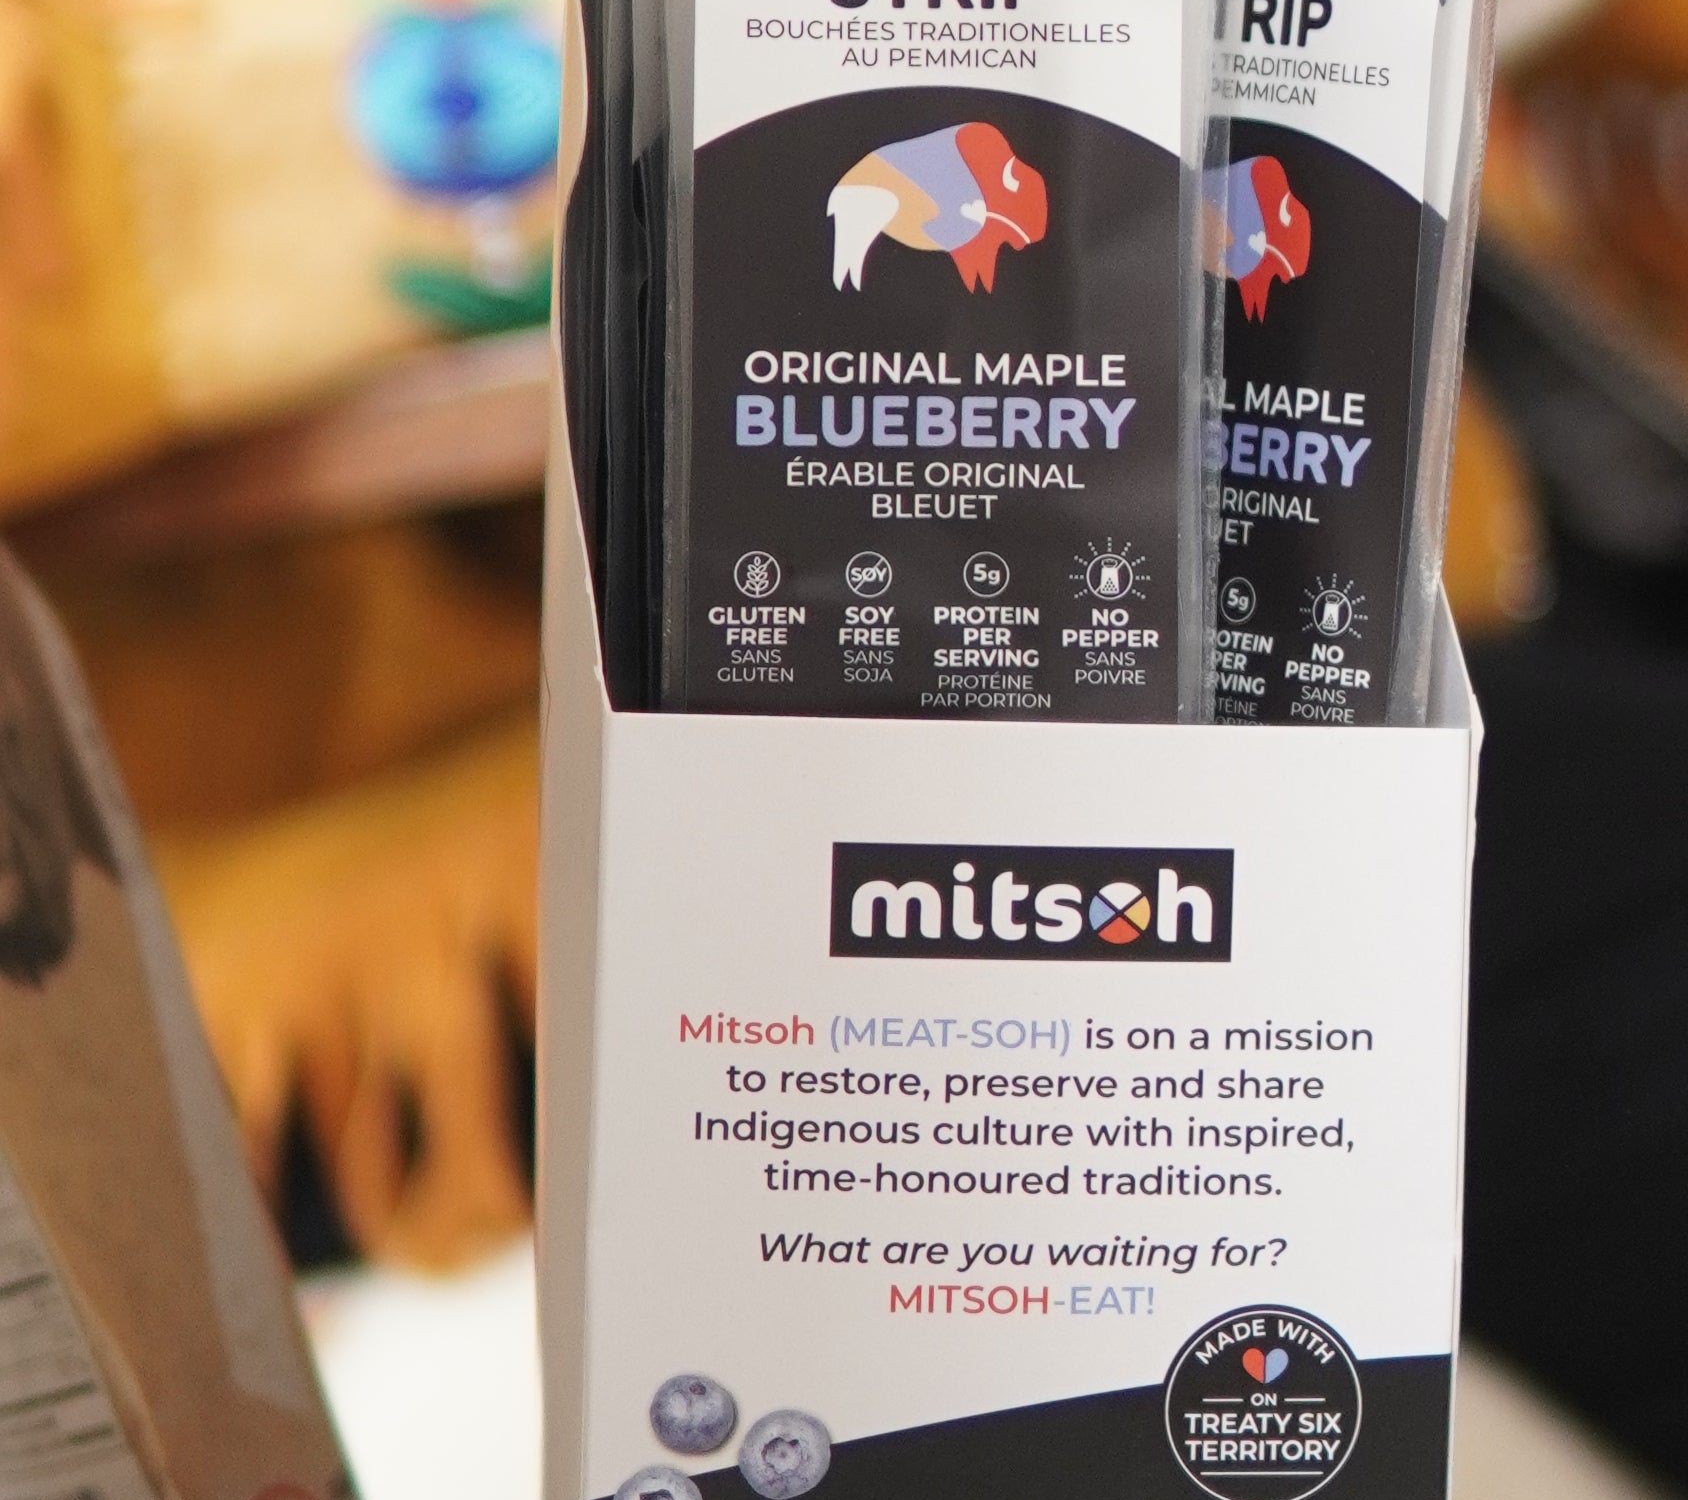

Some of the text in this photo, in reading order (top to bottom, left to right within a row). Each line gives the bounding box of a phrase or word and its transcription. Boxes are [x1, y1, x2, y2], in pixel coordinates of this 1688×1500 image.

[747, 16, 1130, 42] BOUCHÉES TRADITIONELLES
[842, 48, 1035, 68] AU PEMMICAN
[745, 351, 1126, 386] ORIGINAL MAPLE
[1245, 382, 1365, 426] MAPLE
[736, 395, 1136, 449] BLUEBERRY
[1201, 423, 1372, 487] BERRY
[787, 456, 1085, 488] ÉRABLE ORIGINAL
[872, 494, 998, 519] BLEUET
[1222, 487, 1320, 524] RIGINAL
[973, 563, 1001, 585] 5g
[1227, 588, 1249, 611] 5g
[708, 607, 805, 625] GLUTEN
[845, 607, 894, 624] SOY
[934, 606, 1039, 624] PROTEIN
[1092, 609, 1129, 626] NO
[727, 628, 787, 645] FREE
[839, 628, 900, 646] FREE
[964, 628, 1011, 645] PER
[1063, 629, 1159, 647] PEPPER
[1217, 630, 1274, 654] OTEIN
[731, 649, 781, 664] SANS
[844, 650, 894, 664] SANS
[934, 649, 1039, 667] SERVING
[1086, 652, 1135, 666] SANS
[1312, 644, 1344, 664] NO
[717, 667, 793, 682] GLUTEN
[844, 668, 893, 682] SOJA
[938, 671, 1033, 690] PROTÉINE
[1076, 669, 1145, 684] POIVRE
[1285, 661, 1370, 689] PEPPER
[921, 693, 1050, 708] PAR PORTION
[1302, 686, 1346, 704] SANS
[1290, 702, 1355, 724] POIVRE
[850, 862, 1214, 945] mitsoh
[680, 1012, 1372, 1056] Mitsoh (MEAT-SOH) is on a mission
[726, 1066, 1323, 1103] to restore, preserve and share
[695, 1111, 1353, 1154] Indigenous culture with inspired,
[764, 1160, 1281, 1195] time-honoured traditions.
[761, 1233, 1287, 1274] What are you waiting for?
[891, 1285, 1153, 1314] MITSOH-EAT!
[1195, 1319, 1335, 1365] MADE WITH
[1251, 1393, 1277, 1406] ON
[1185, 1413, 1341, 1434] TREATY SIX
[1185, 1440, 1340, 1461] TERRITORY
